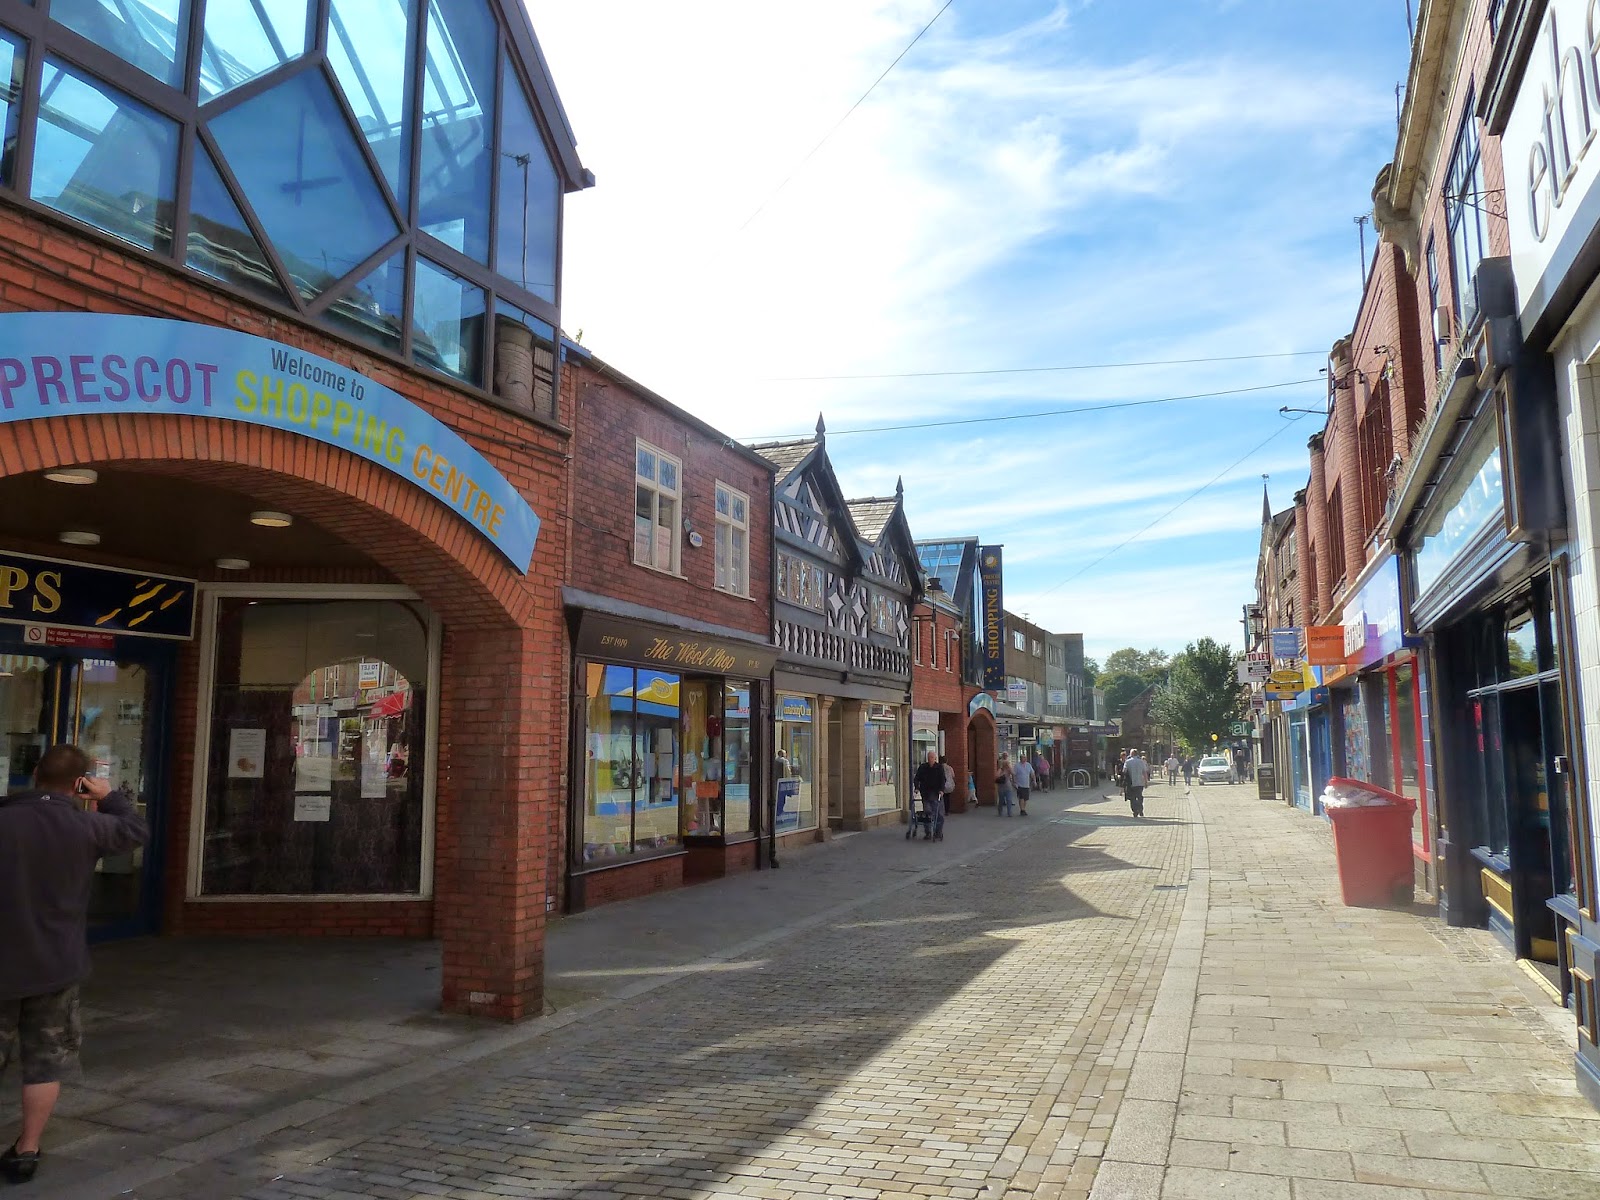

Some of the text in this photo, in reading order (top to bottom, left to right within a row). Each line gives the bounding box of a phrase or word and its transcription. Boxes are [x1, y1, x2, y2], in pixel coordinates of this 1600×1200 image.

[1527, 0, 1600, 243] eth
[271, 347, 366, 401] Welcome to
[0, 354, 506, 538] PRESCOT SHOPPING CENTRE
[987, 588, 999, 659] SHOPPING
[644, 638, 674, 660] The
[674, 642, 712, 665] Wool
[706, 648, 736, 672] Shop
[1247, 653, 1257, 661] TO
[1258, 652, 1270, 660] LET
